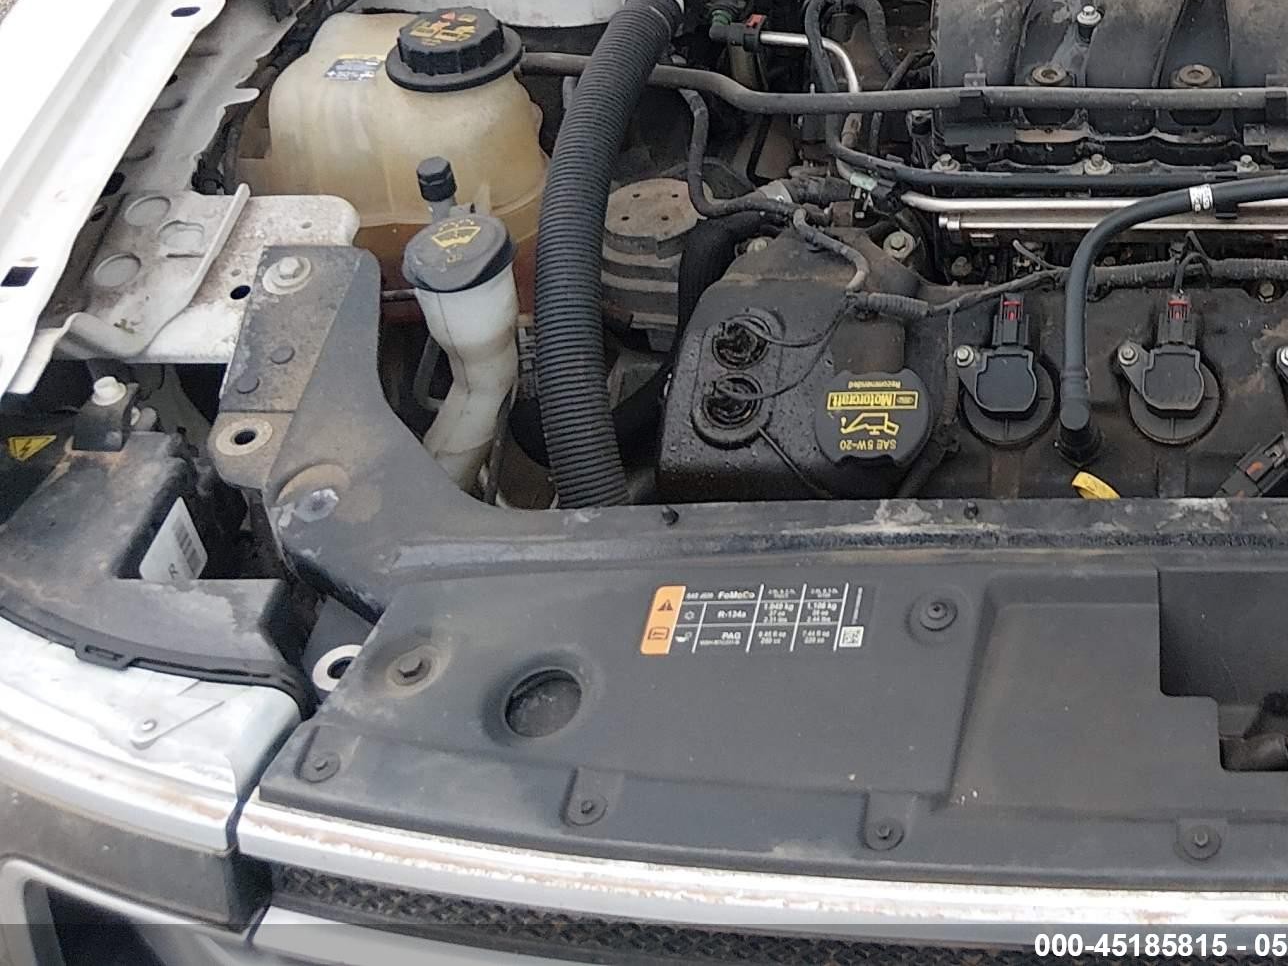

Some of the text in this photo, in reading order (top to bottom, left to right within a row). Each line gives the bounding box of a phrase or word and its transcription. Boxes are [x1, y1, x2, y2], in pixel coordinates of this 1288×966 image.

[832, 393, 893, 407] Motorcraft
[840, 439, 897, 451] SAE 5W-20
[718, 591, 755, 599] FoMoCo
[717, 609, 747, 619] R-134a
[721, 631, 742, 640] PAG
